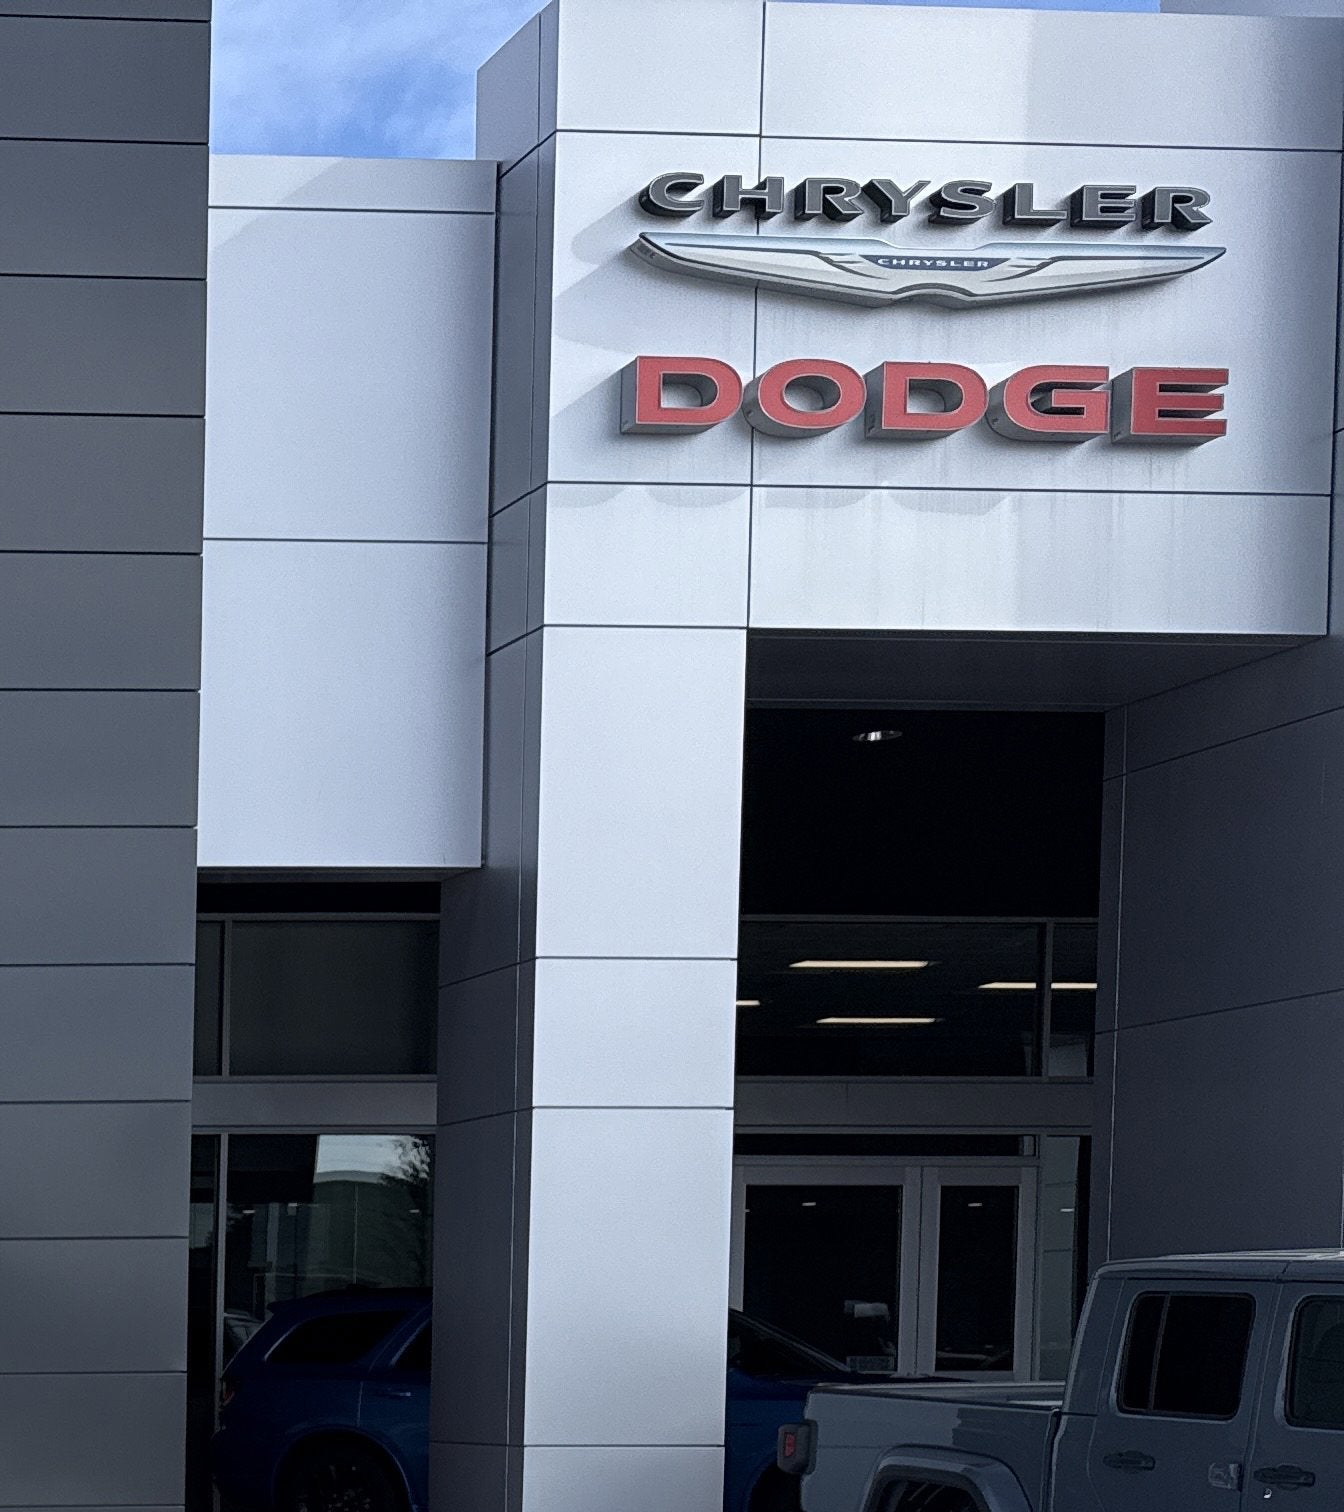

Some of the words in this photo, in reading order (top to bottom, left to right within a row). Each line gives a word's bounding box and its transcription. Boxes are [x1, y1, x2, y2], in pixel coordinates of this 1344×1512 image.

[638, 171, 1214, 231] CHRYSLER
[877, 258, 989, 268] CHRYSLER
[620, 354, 1230, 446] DODGE
